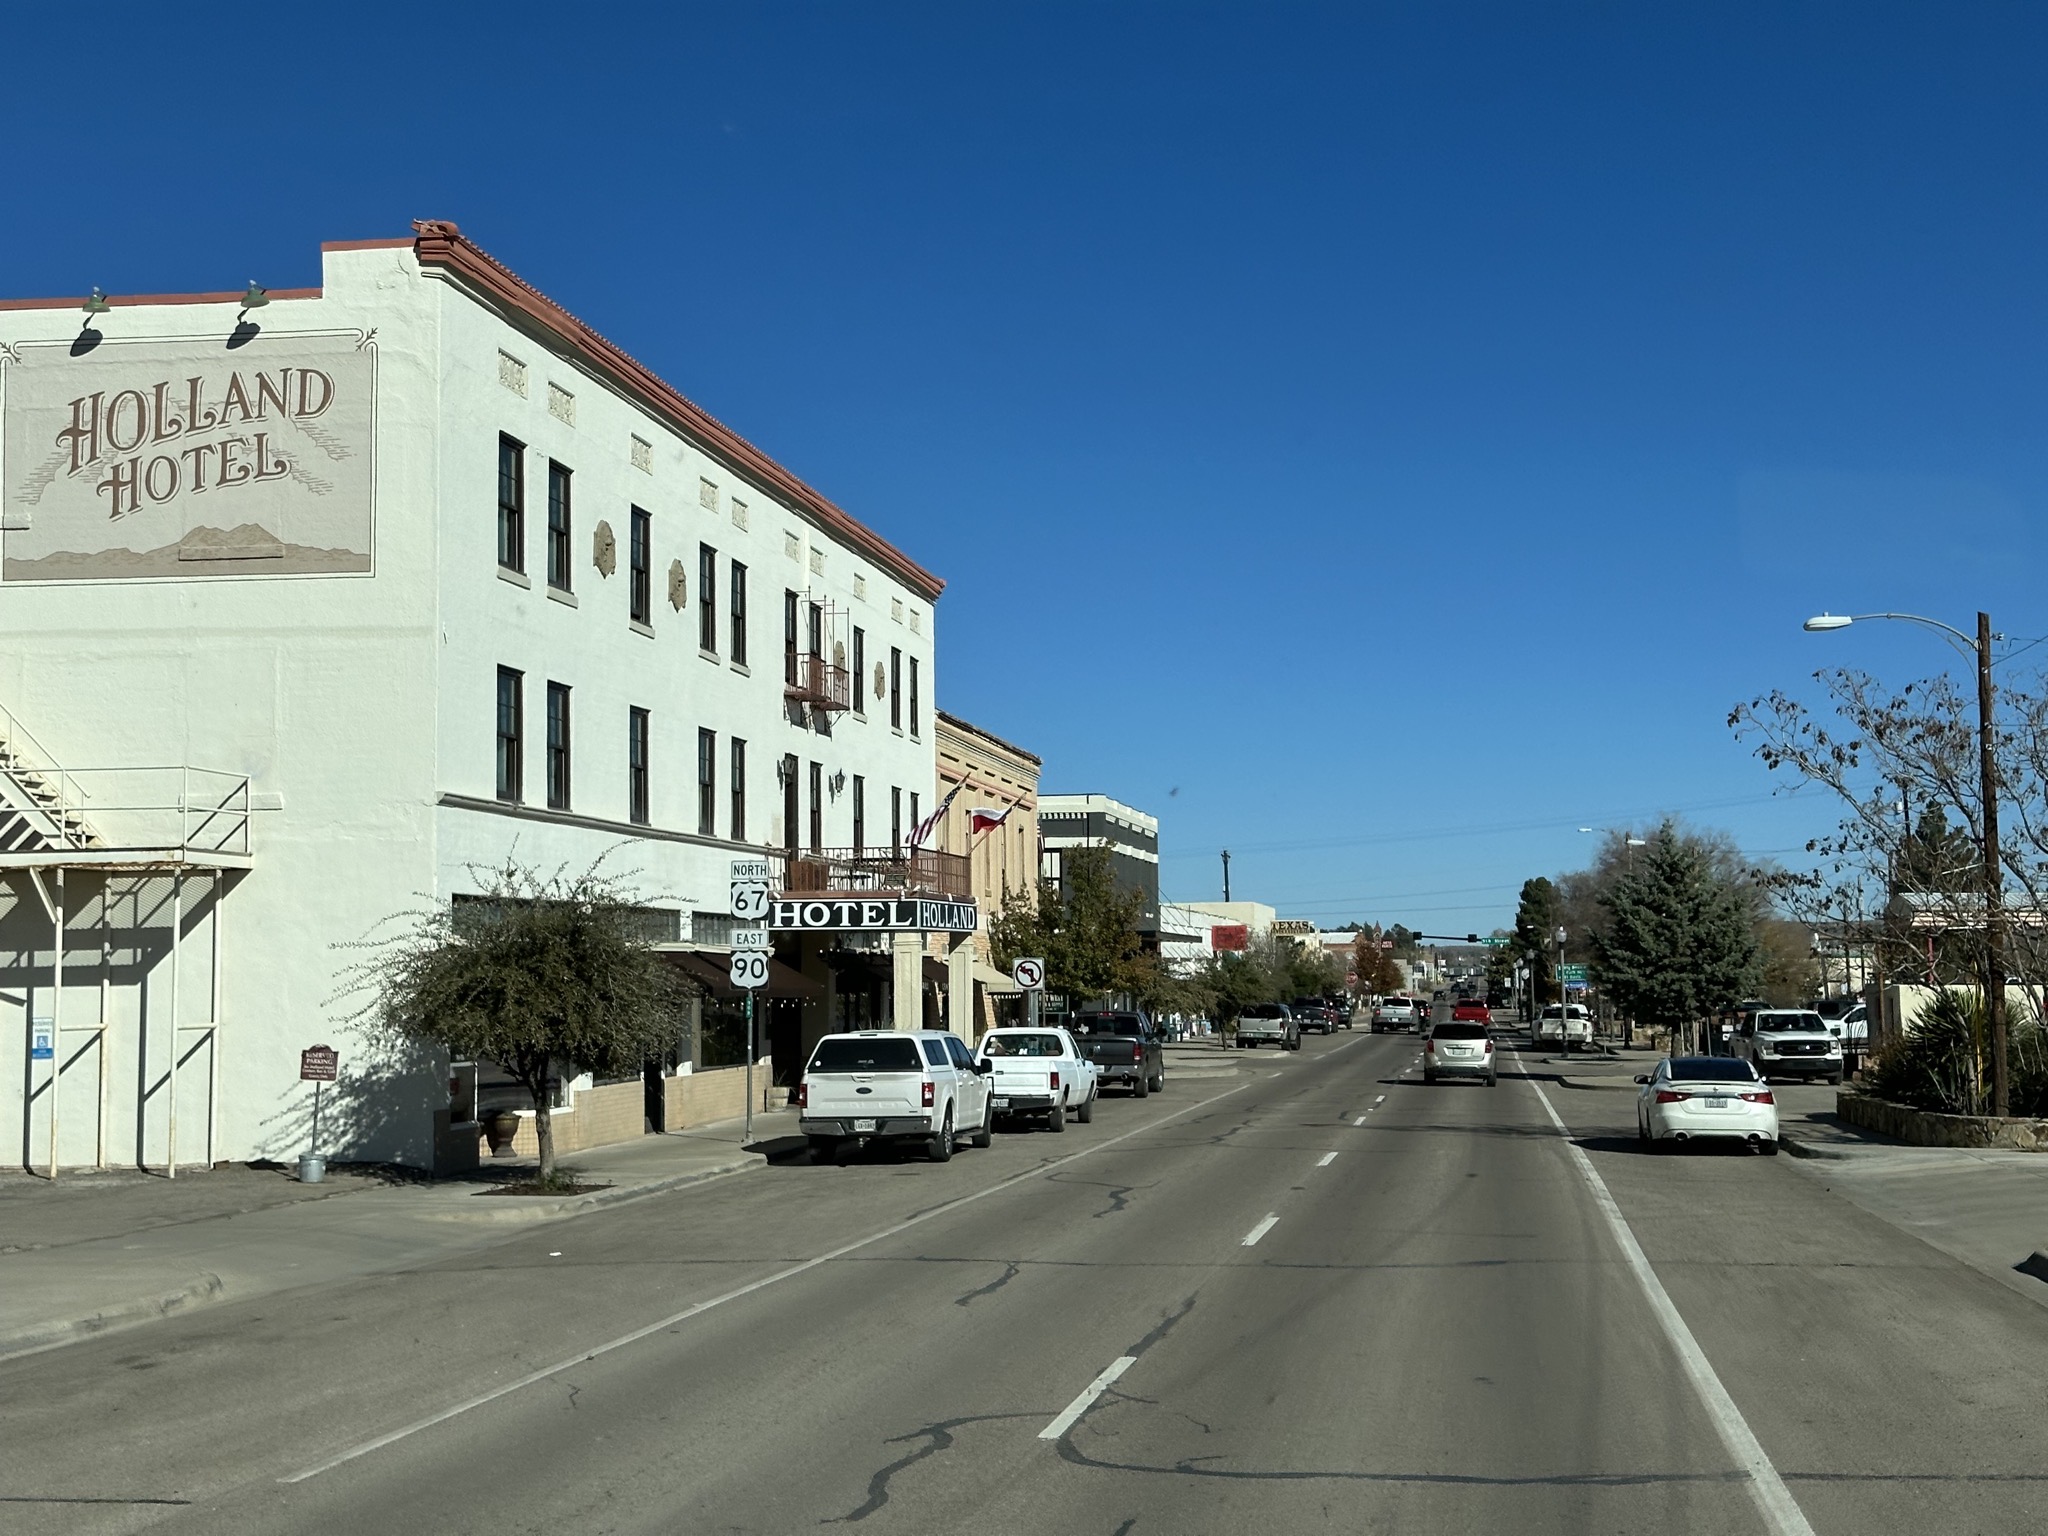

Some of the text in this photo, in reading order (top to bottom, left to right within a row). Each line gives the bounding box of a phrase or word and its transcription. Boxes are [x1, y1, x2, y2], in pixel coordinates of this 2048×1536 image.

[55, 368, 336, 479] HOLLAND
[96, 433, 292, 522] HOTEL
[733, 864, 767, 876] NORTH
[734, 890, 765, 911] 67
[772, 901, 913, 927] HOTEL
[922, 902, 975, 929] HOLLAND
[1271, 921, 1309, 930] TEXAS
[736, 933, 763, 944] EAST
[734, 957, 765, 979] 90
